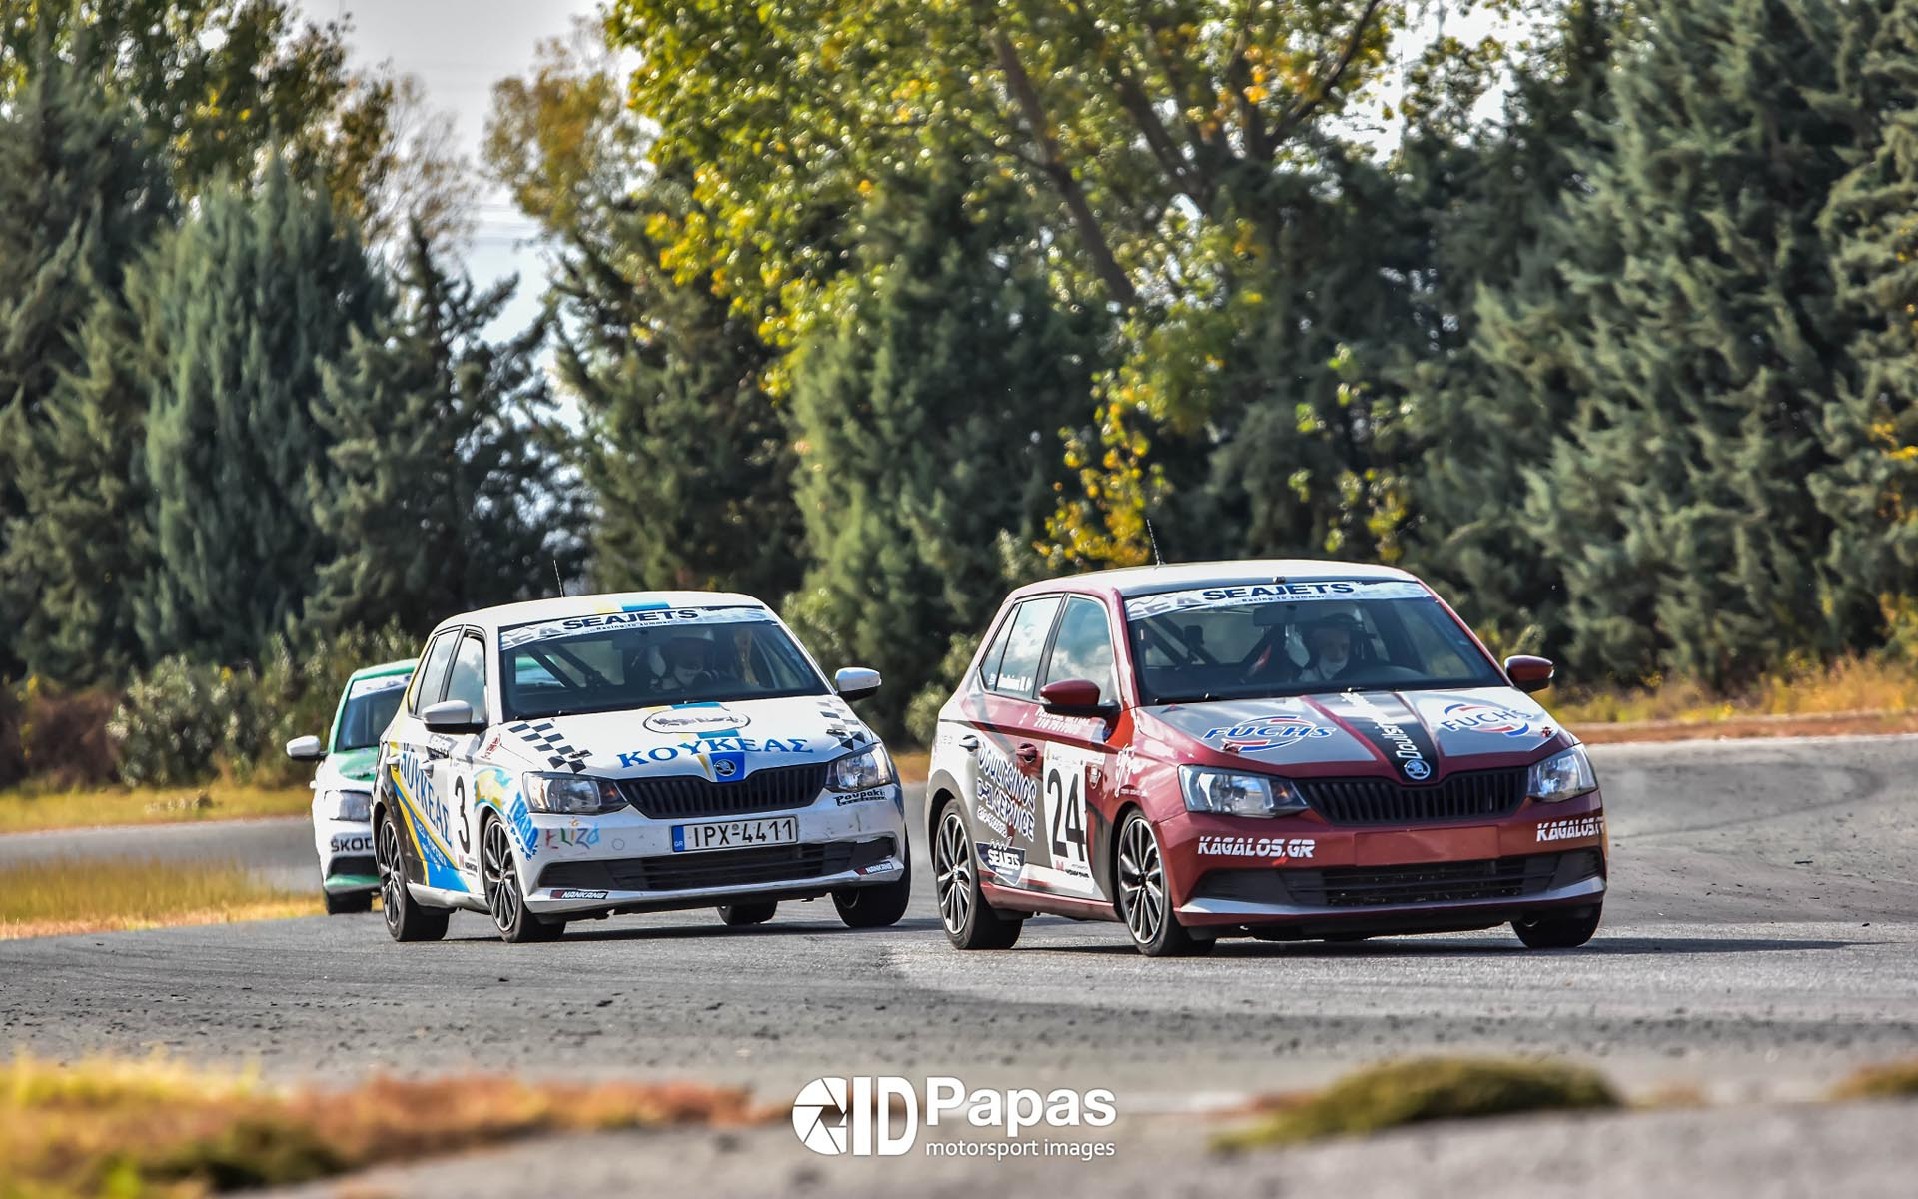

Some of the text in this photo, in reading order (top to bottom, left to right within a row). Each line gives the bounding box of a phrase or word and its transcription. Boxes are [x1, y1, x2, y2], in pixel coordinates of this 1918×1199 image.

[1202, 584, 1354, 601] SEAJETS
[563, 609, 698, 630] SEAJETS
[1440, 708, 1533, 732] FUCHS
[1202, 726, 1337, 740] FUCHS
[617, 738, 814, 769] ΚΟΥΚΕΑΣ
[455, 775, 470, 854] 3
[1047, 768, 1086, 862] 24
[331, 836, 374, 852] ŠKOD
[1197, 836, 1316, 858] KAGALOS.GR
[561, 891, 607, 899] NANKANG
